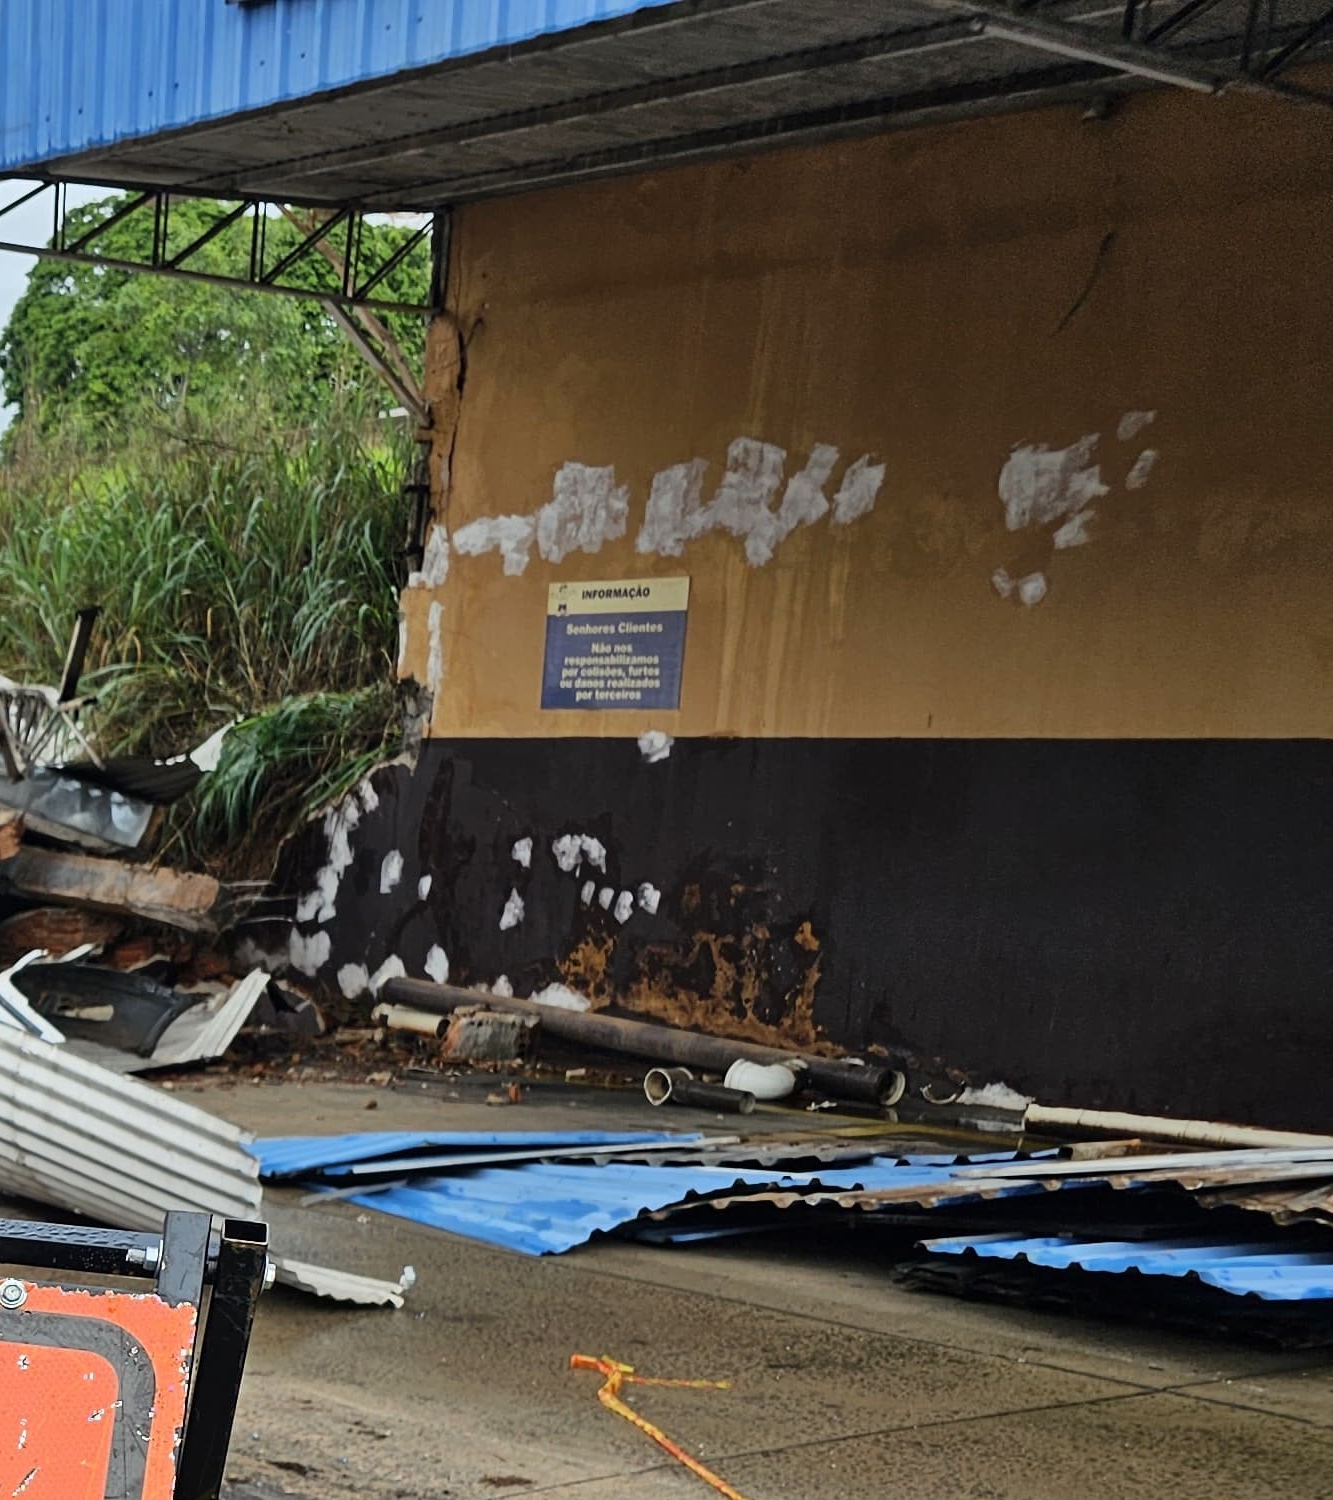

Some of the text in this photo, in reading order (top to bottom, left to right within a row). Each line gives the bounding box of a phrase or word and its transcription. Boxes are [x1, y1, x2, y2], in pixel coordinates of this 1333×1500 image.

[581, 585, 651, 600] INFORMAÇÃO
[565, 621, 663, 635] Senhores Clientes
[591, 642, 633, 653] Não nos
[564, 654, 660, 666] responsabilizamos
[561, 668, 578, 679] por
[629, 665, 660, 676] furtos
[559, 677, 661, 688] ou danos realizados
[575, 688, 641, 701] por terceiros
